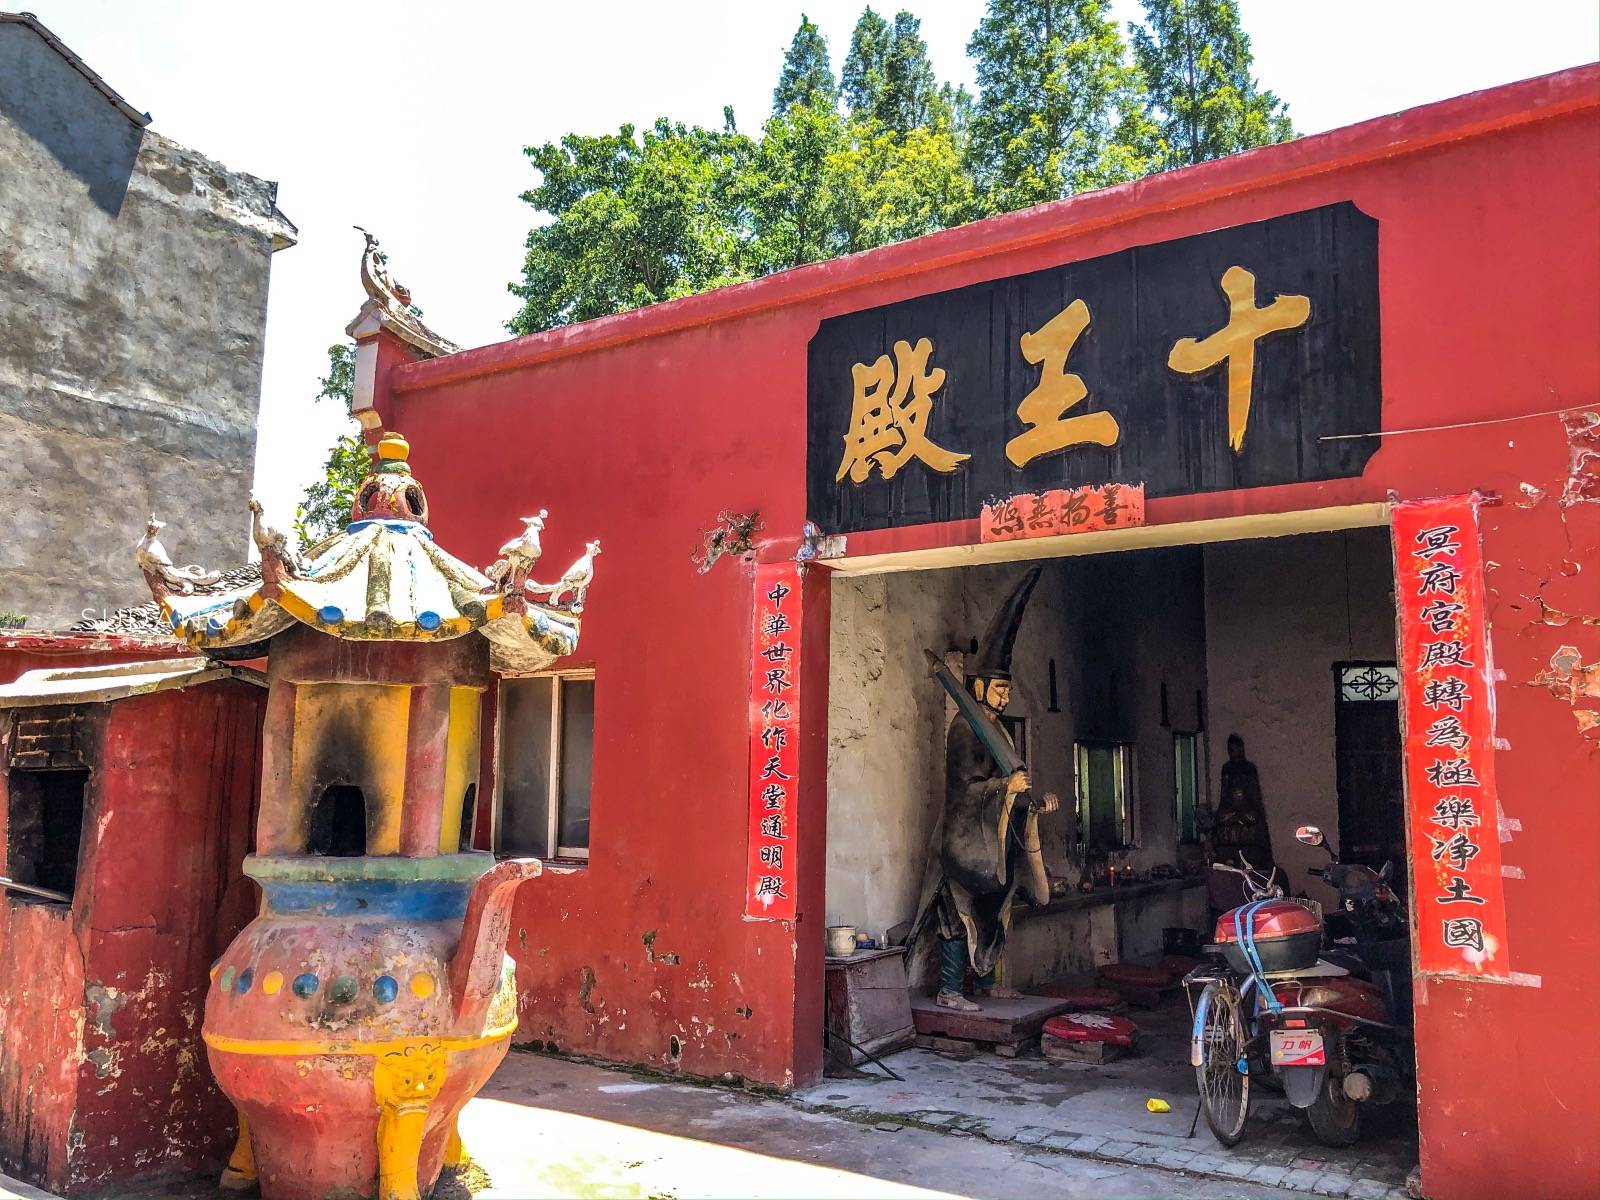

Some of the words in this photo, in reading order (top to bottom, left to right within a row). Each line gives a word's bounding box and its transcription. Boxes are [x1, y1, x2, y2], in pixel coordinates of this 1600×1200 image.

[836, 266, 1311, 483] 十王殿
[757, 584, 792, 898] 中華世界化作天堂通明殿
